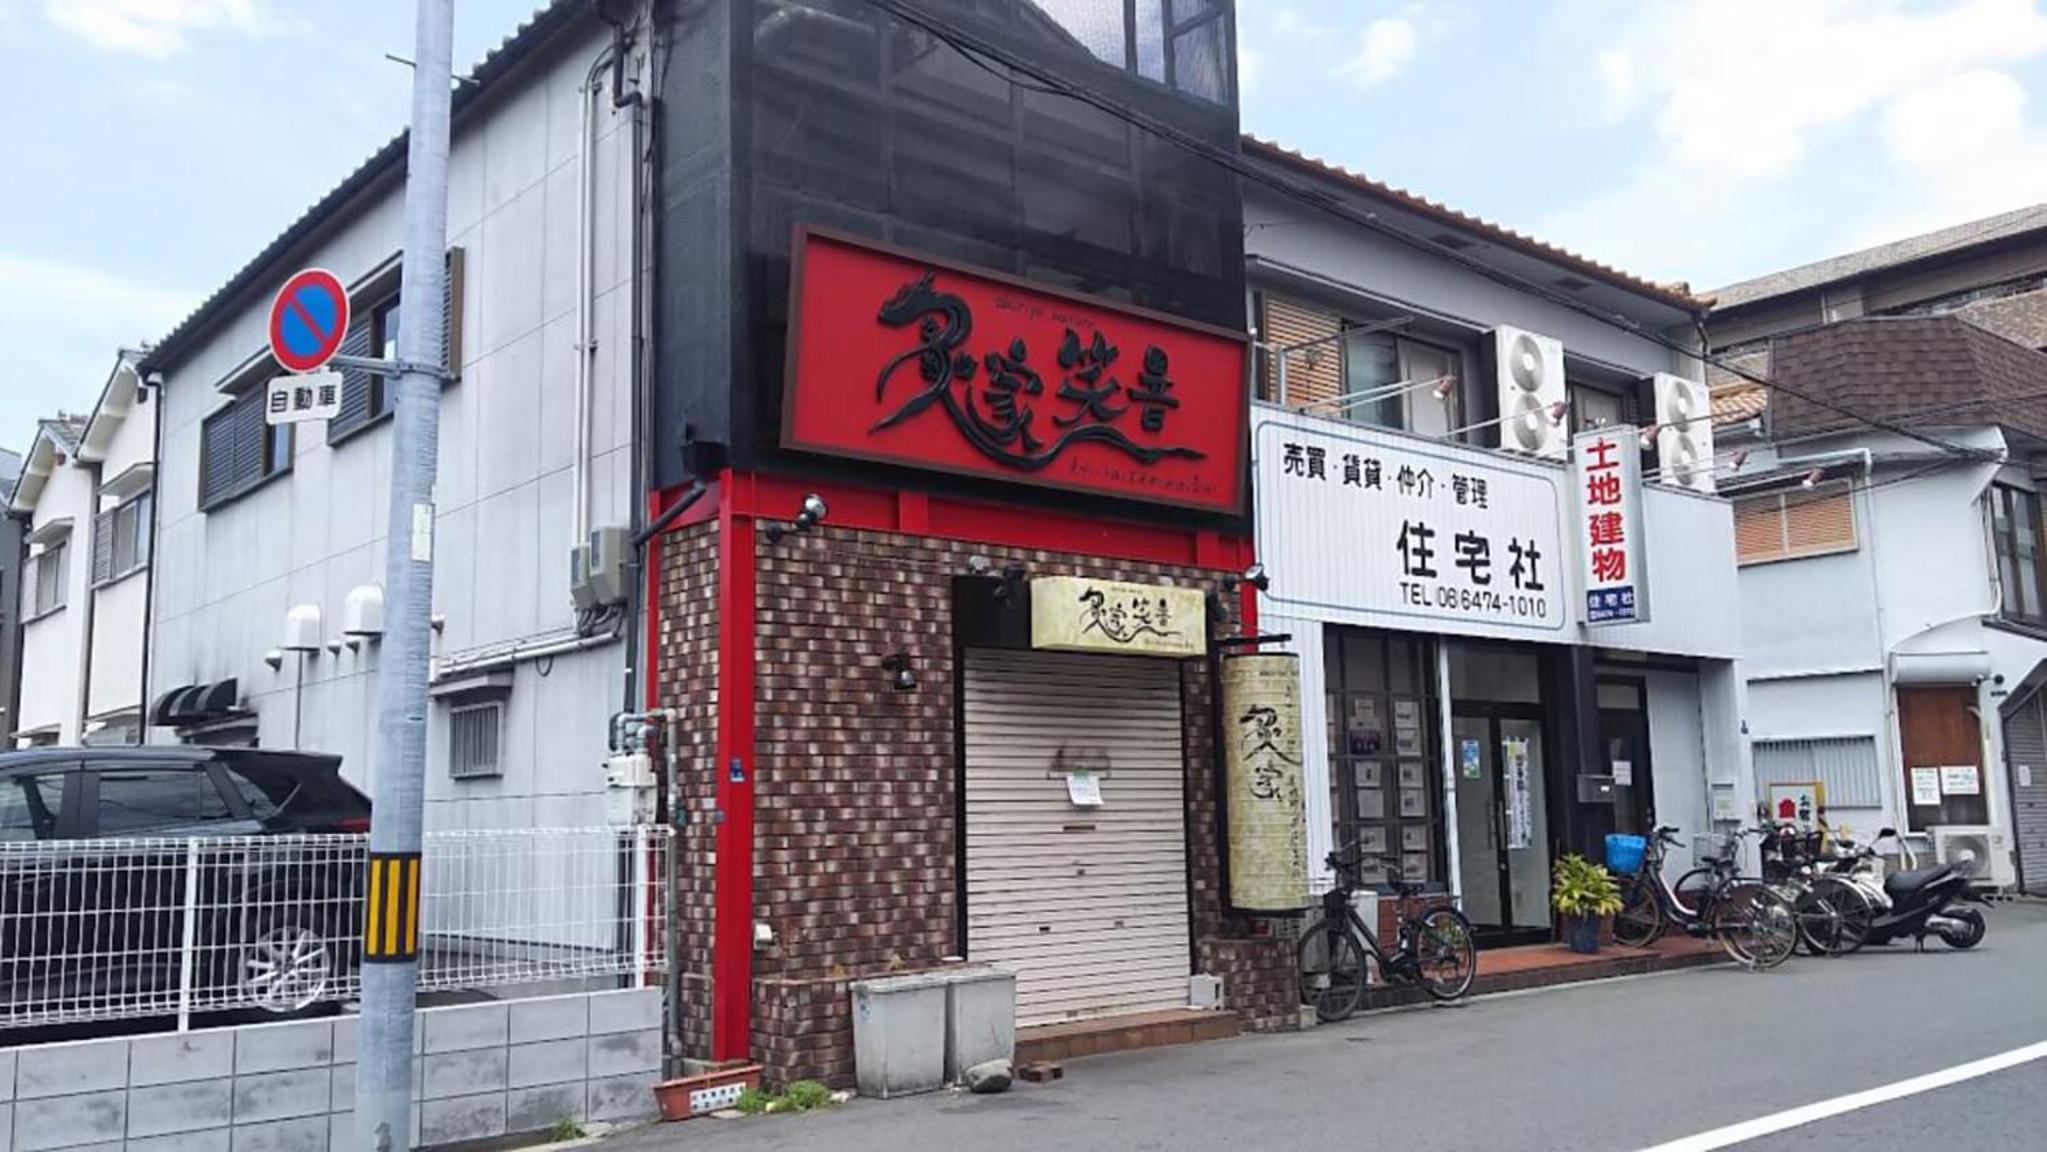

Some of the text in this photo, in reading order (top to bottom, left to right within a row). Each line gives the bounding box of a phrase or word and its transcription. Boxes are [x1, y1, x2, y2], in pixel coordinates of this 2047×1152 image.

[271, 384, 336, 413] 自動車
[1586, 437, 1626, 583] 土地建物
[1397, 519, 1544, 591] 住宅社
[1400, 582, 1432, 607] TEL
